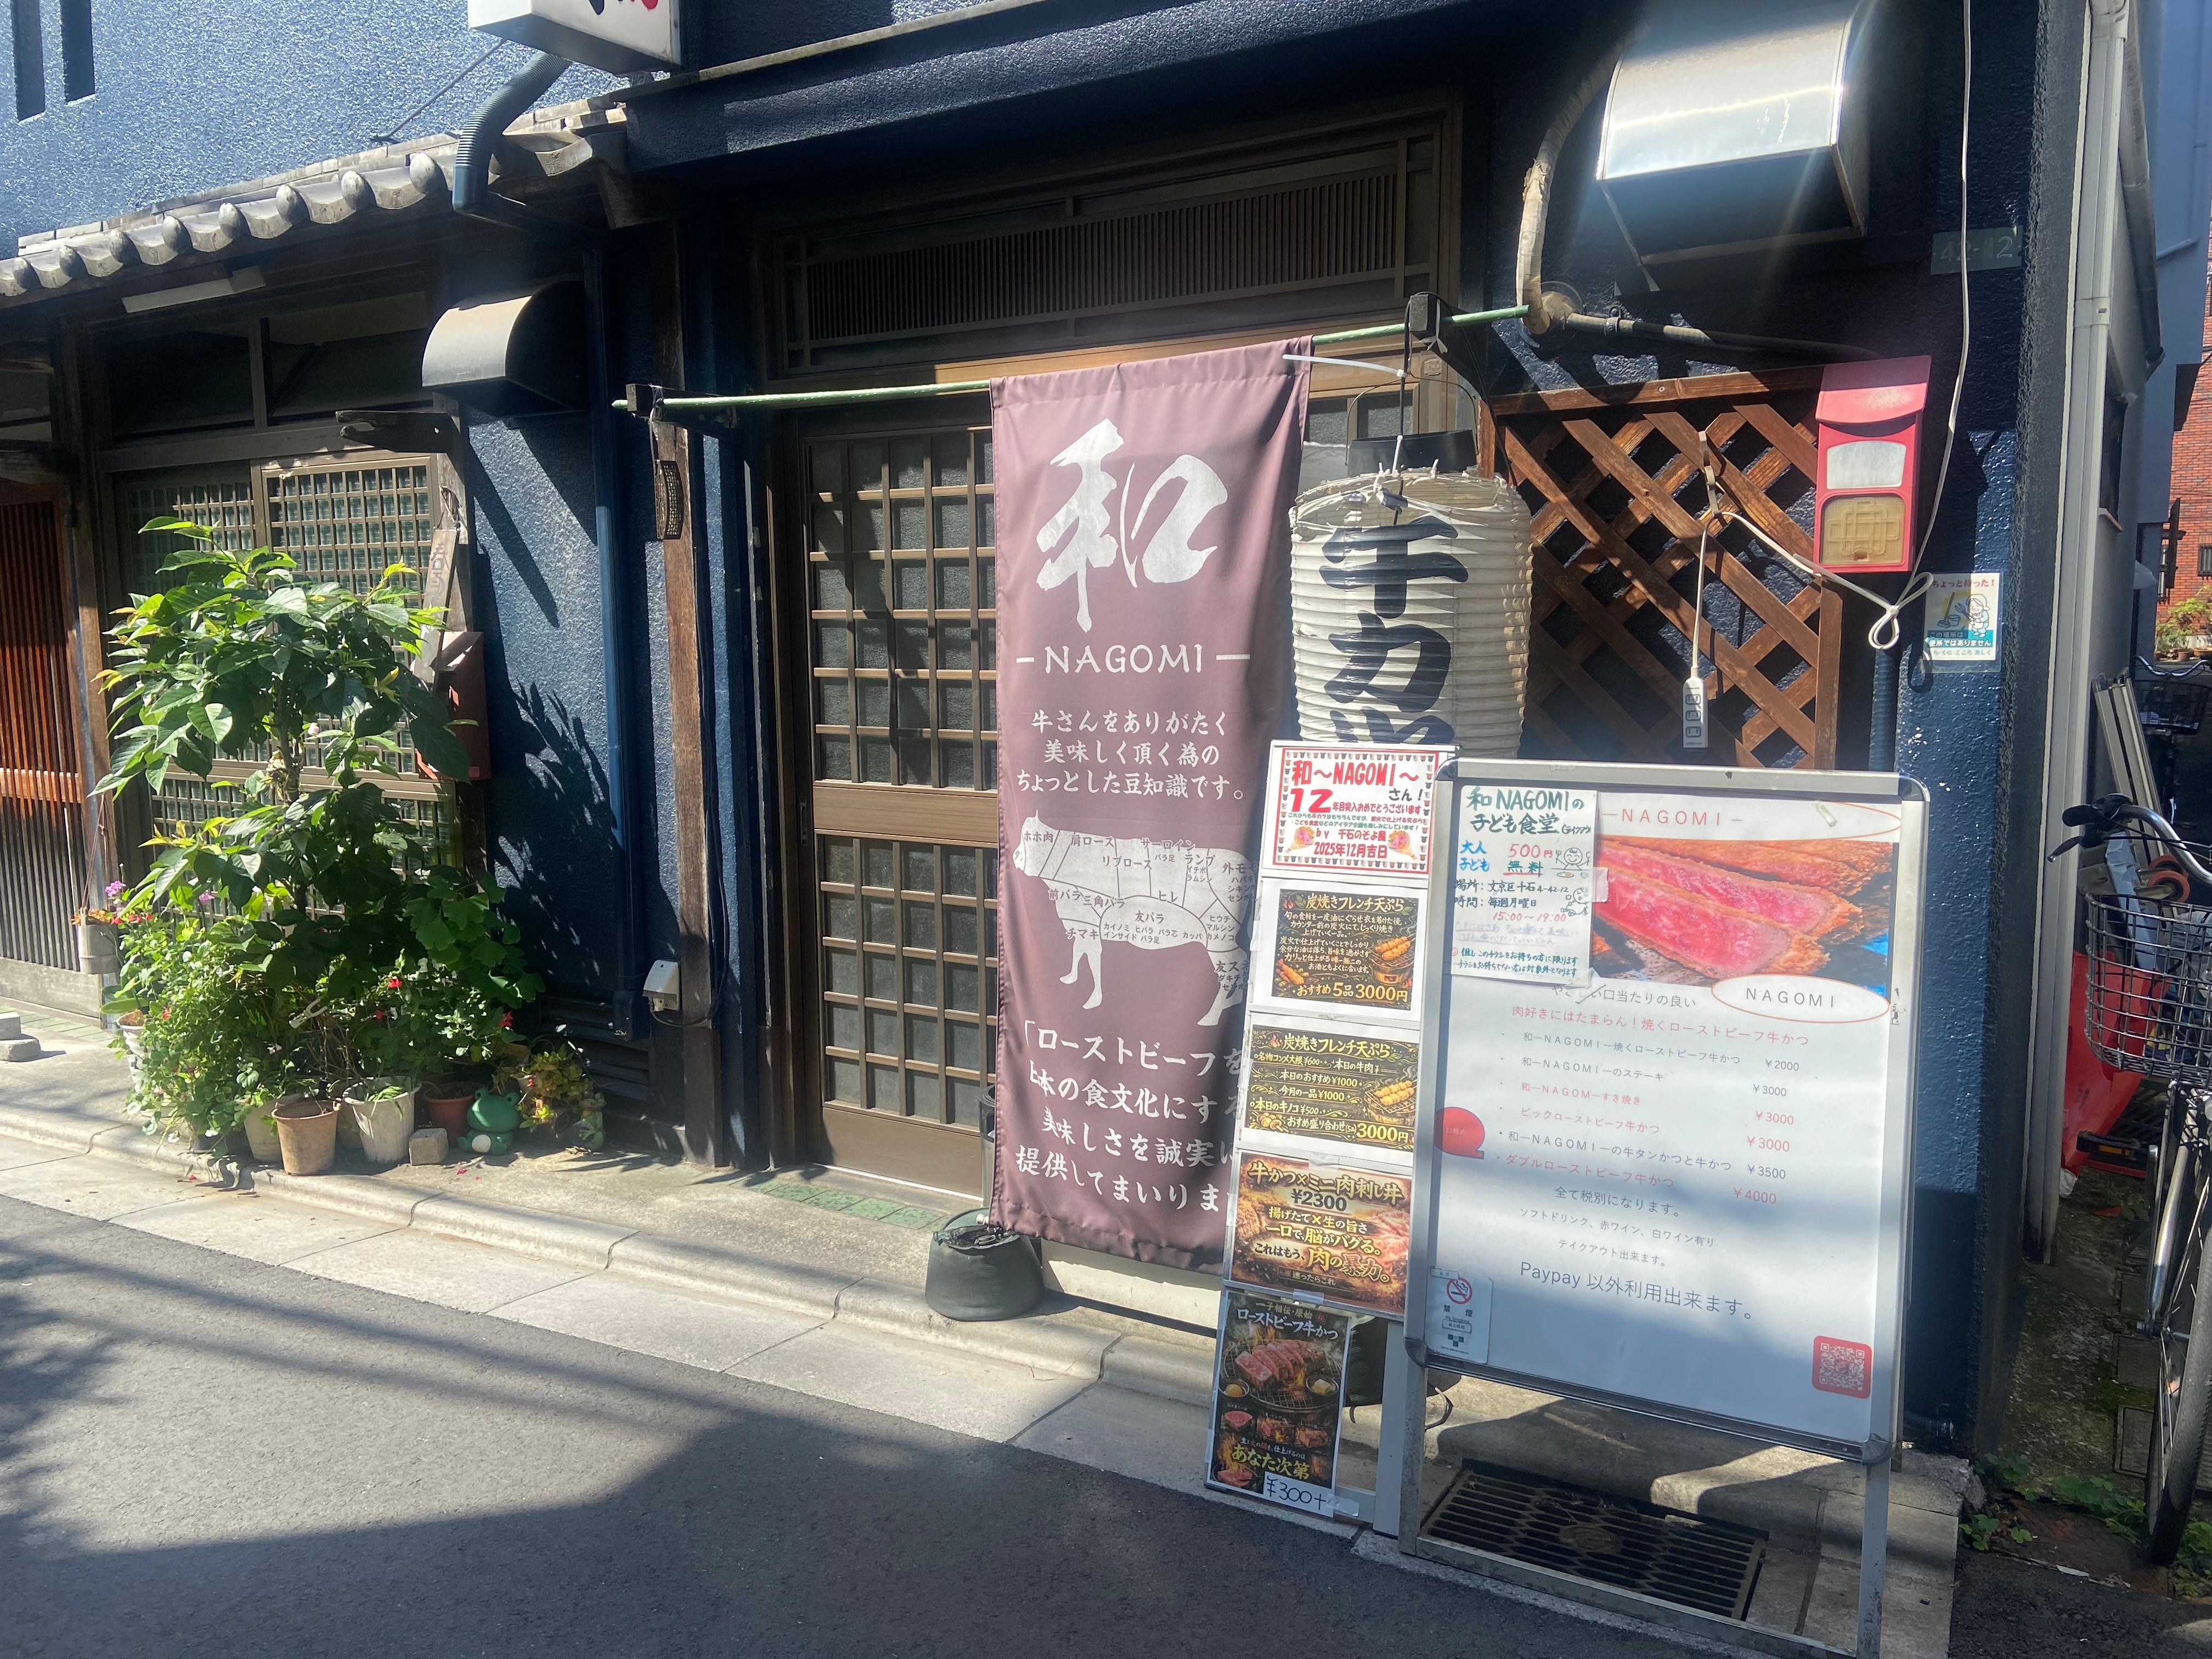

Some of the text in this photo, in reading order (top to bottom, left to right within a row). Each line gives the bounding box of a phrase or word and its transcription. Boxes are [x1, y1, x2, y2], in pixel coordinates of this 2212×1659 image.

[1036, 418, 1228, 633] 和
[1044, 644, 1203, 673] NAGOMI
[1031, 709, 1226, 736] 牛さんをありがたく
[1043, 739, 1219, 767] 美味しく頂く為の
[1017, 769, 1244, 800] ちょっとした豆知識です。
[1290, 788, 1334, 813] 12
[1332, 802, 1421, 815] 年目突入おめでとうございます
[1470, 812, 1560, 835] 子ども食堂
[1024, 831, 1053, 843] ホホ肉
[1070, 834, 1114, 848] 肩ロース
[1141, 837, 1196, 851] サーロイン
[1313, 842, 1388, 859] 2025年12月吉日
[1460, 840, 1553, 859] 大人 500円
[1103, 855, 1152, 871] リブロース
[1184, 854, 1216, 867] ランプ
[1459, 857, 1544, 877] 子ども 無料
[1048, 889, 1081, 900] 前バラ
[1082, 895, 1125, 909] 三角バラ
[1158, 890, 1178, 902] ヒレ
[1305, 892, 1404, 912] 炭焼きフレンチ天ぷら
[1488, 896, 1537, 909] 毎週月曜日
[1135, 910, 1164, 924] 友バラ
[1066, 928, 1099, 939] チマキ
[1104, 932, 1137, 940] インサイド
[1206, 924, 1235, 932] マルシン
[1206, 933, 1235, 941] カメノコ
[1355, 984, 1408, 1002] 3000円
[1746, 988, 1834, 1008] NAGOMI
[1282, 1032, 1392, 1058] 炭焼きフレンチ天ぷら
[1279, 1069, 1331, 1085] 本日のおすすめ
[1278, 1084, 1318, 1099] 今月の一品
[1255, 1097, 1299, 1114] 本日のキノコ
[1356, 1122, 1409, 1143] 3000円
[1015, 1145, 1220, 1212] 提供してまいりま
[1291, 1188, 1347, 1212] ¥2300
[1554, 1186, 1679, 1217] 全て税別になります。
[1520, 1208, 1714, 1247] ソフトドリンク、赤ワイン、白ワイン有り
[1266, 1224, 1381, 1256] 一口で、脳がバグる。
[1558, 1239, 1666, 1267] テイクアウト出来ます。
[1520, 1261, 1751, 1319] Paypay 以外利用出来ます。
[1237, 1308, 1339, 1340] ローストビーフ牛かつ
[1231, 1443, 1311, 1480] あなた次第
